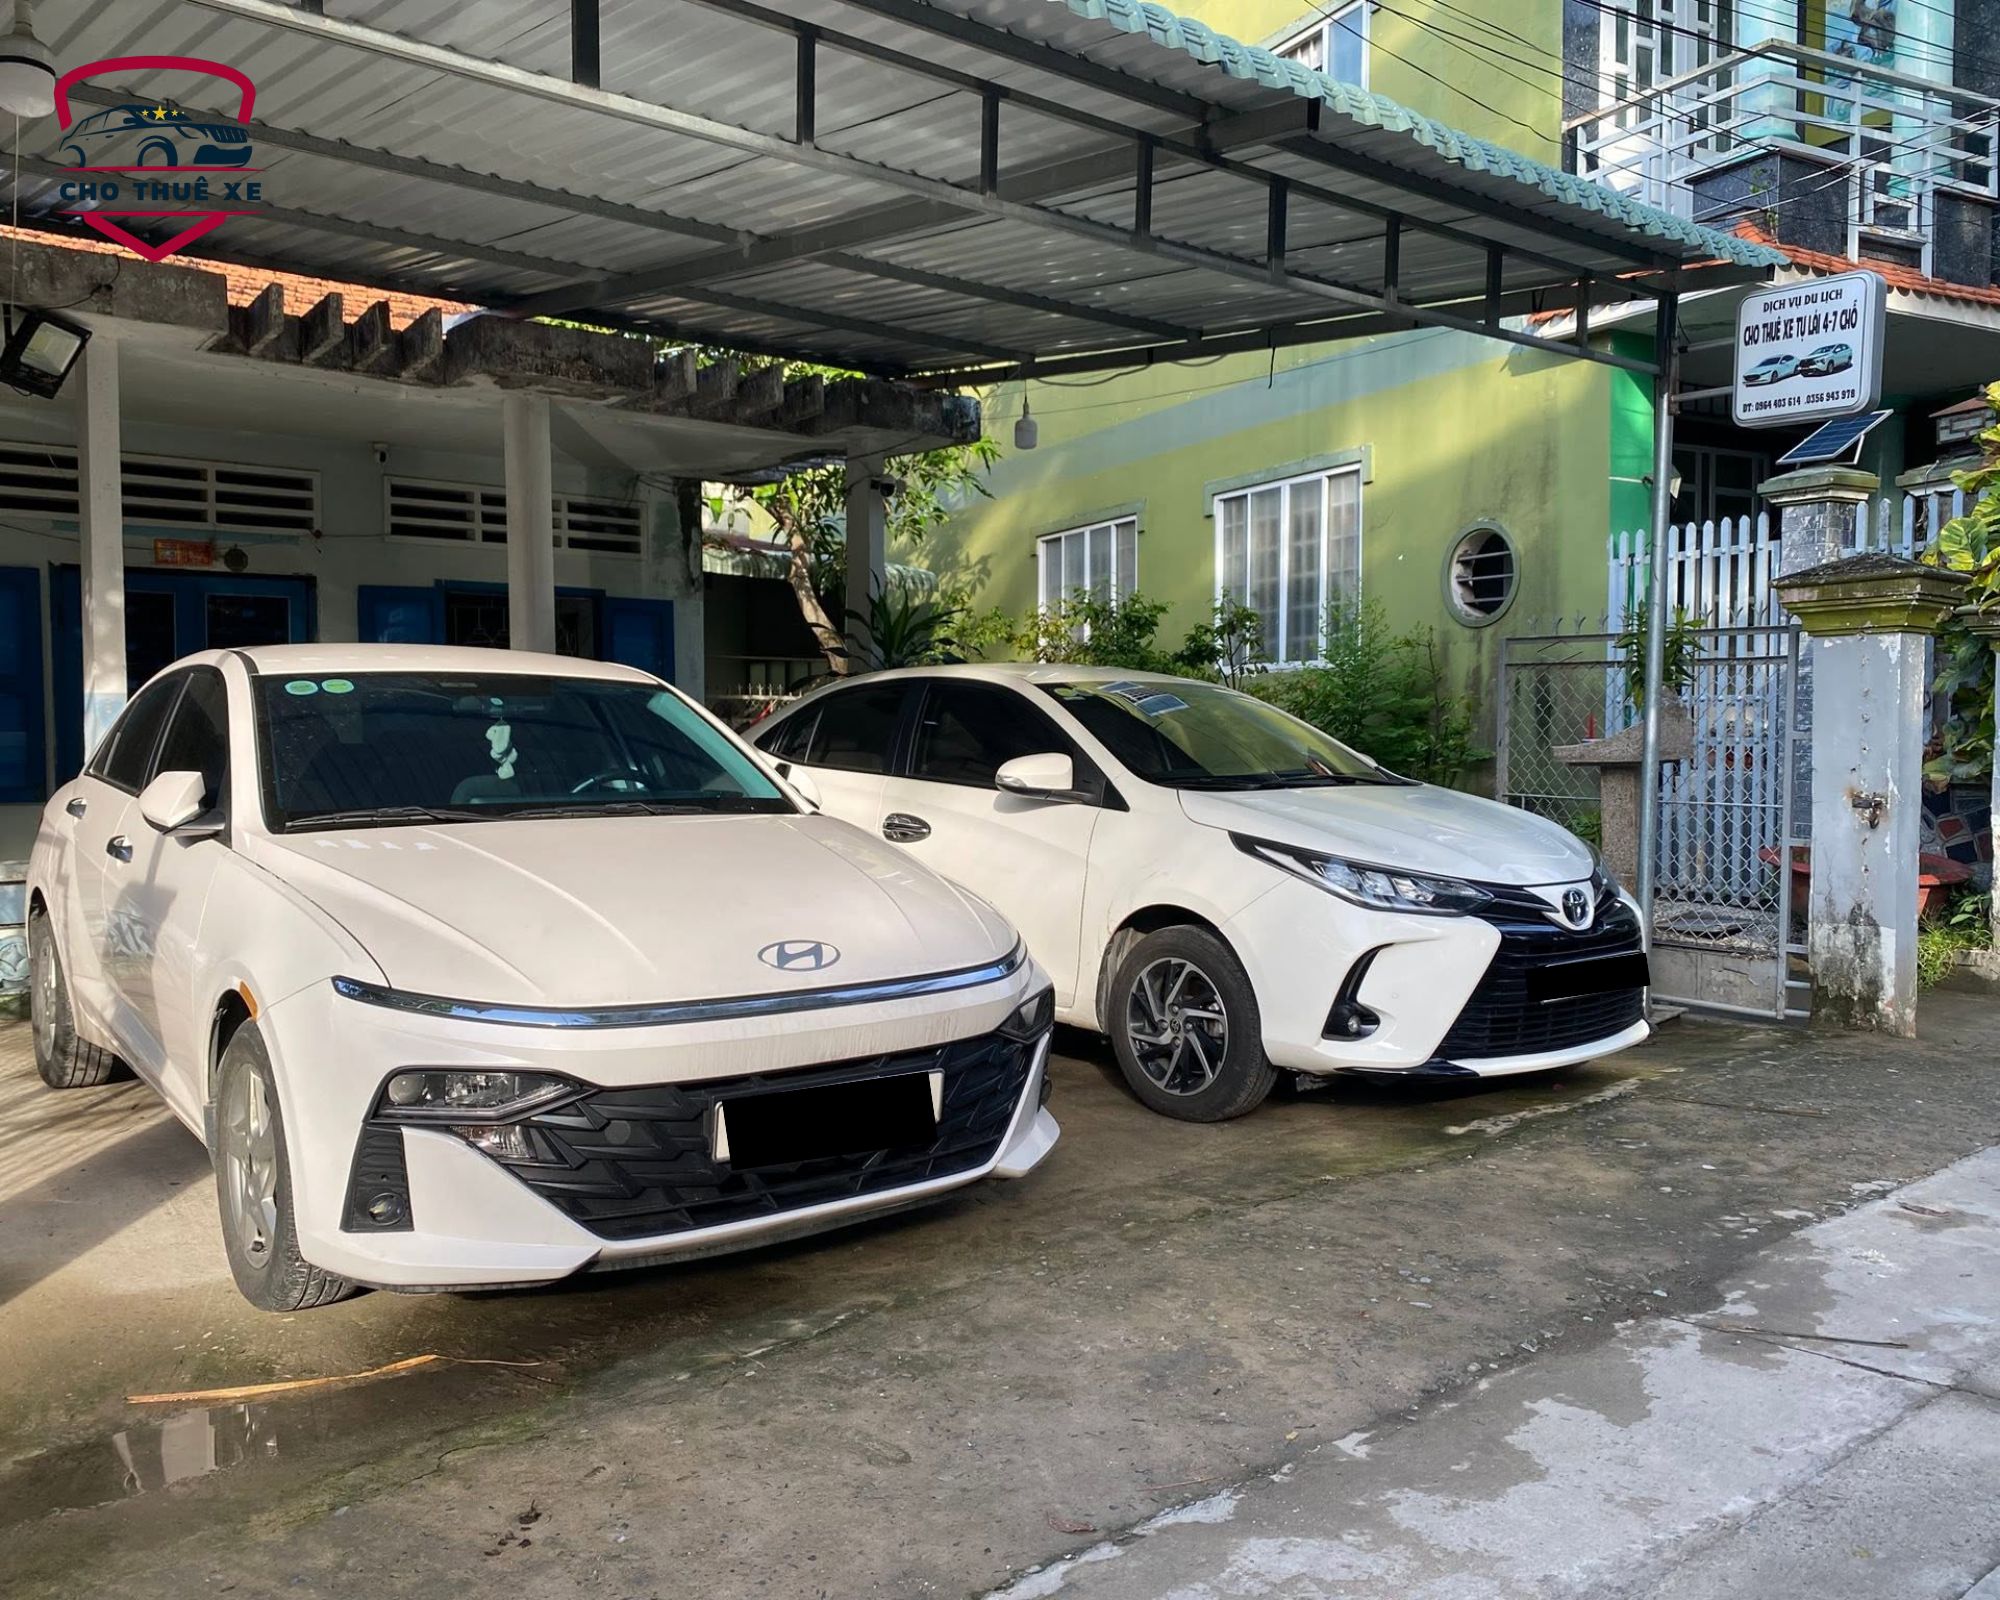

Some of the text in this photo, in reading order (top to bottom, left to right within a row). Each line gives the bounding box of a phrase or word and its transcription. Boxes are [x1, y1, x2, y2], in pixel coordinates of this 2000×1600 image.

[1763, 289, 1843, 314] DỊCH VỤ DU LỊCH
[1743, 324, 1760, 346] CHO
[1762, 316, 1781, 343] THUÊ
[1782, 318, 1794, 340] XE
[1823, 310, 1838, 333] 4-7
[1841, 388, 1856, 400] 978
